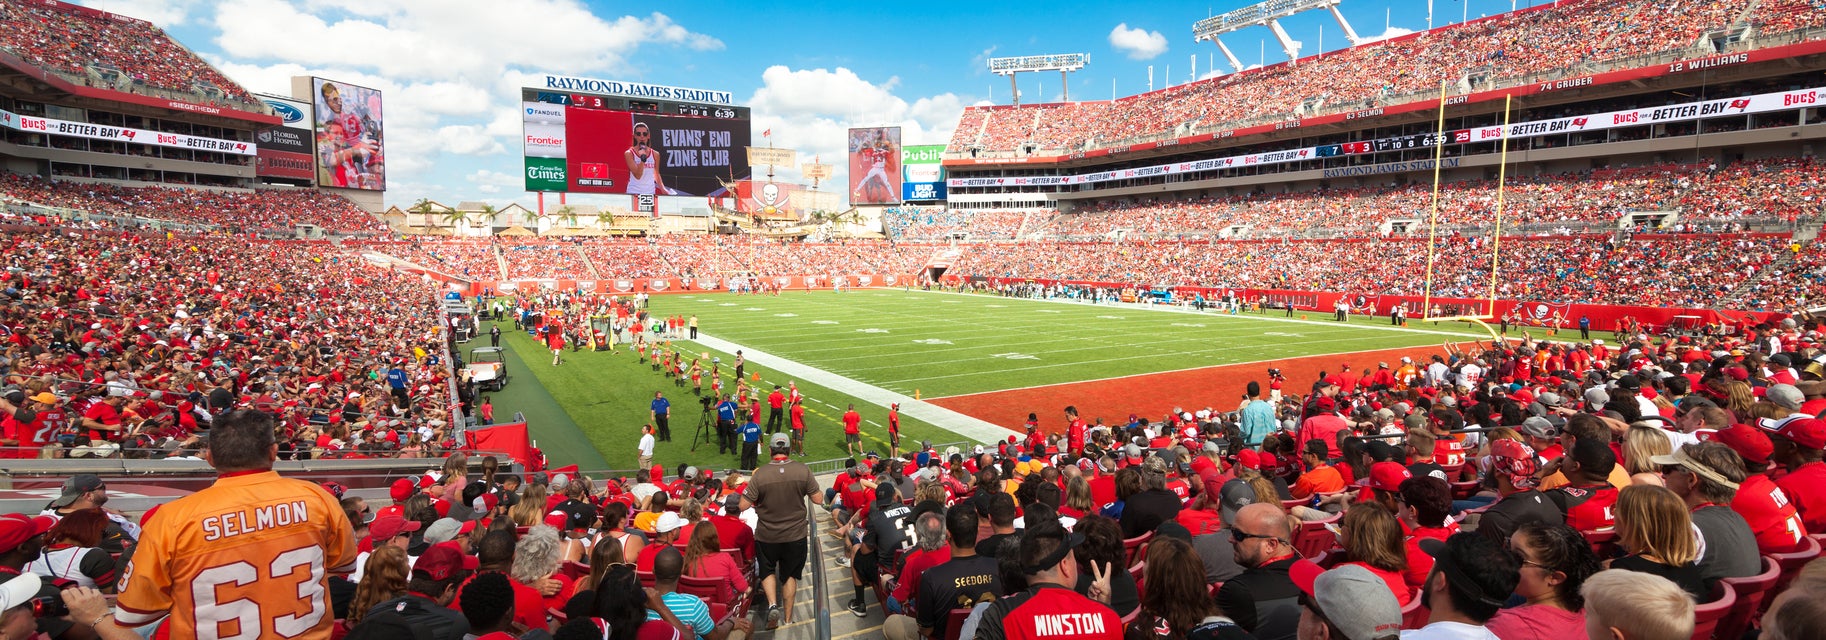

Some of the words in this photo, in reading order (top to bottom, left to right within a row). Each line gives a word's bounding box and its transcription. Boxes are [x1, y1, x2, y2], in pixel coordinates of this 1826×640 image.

[1669, 63, 1683, 73] 12
[1689, 53, 1749, 70] WILLIAMS
[546, 76, 623, 96] RAYMOND
[625, 84, 670, 99] JAMES
[674, 90, 730, 104] STADIUM
[1540, 82, 1552, 91] 74
[1556, 77, 1593, 89] GRUBER
[560, 96, 567, 104] 7
[594, 99, 601, 107] 3
[1784, 91, 1817, 106] BUCS
[169, 102, 220, 115] #SIEGETHEDAY
[534, 109, 562, 119] FANDUEL
[715, 110, 735, 119] 6:39
[1357, 108, 1384, 118] SELMON
[1613, 111, 1639, 124] BUCS
[1652, 105, 1698, 120] BETTER
[1701, 101, 1728, 115] BAY
[21, 117, 46, 131] BUCS
[59, 123, 97, 136] BETTER
[100, 126, 120, 139] BAY
[1481, 127, 1501, 139] BUCS
[1511, 122, 1547, 136] BETTER
[1550, 119, 1571, 132] BAY
[273, 130, 299, 140] FLORIDA
[527, 135, 563, 145] Frontier
[661, 129, 706, 147] EVANS'
[709, 130, 731, 148] END
[1456, 132, 1469, 141] 25
[157, 133, 177, 144] BUCS
[187, 138, 217, 149] BETTER
[219, 142, 235, 152] BAY
[273, 137, 303, 147] HOSPITAL
[1363, 143, 1370, 152] 3
[1392, 141, 1402, 149] 10
[1263, 153, 1284, 162] BETTER
[1285, 151, 1298, 160] BAY
[1332, 146, 1338, 155] 7
[666, 149, 698, 168] ZONE
[701, 149, 729, 167] CLUB
[1195, 161, 1214, 169] BETTER
[1214, 159, 1225, 167] BAY
[527, 166, 565, 180] Times
[1324, 166, 1370, 178] RAYMOND
[1372, 162, 1407, 173] JAMES
[1410, 158, 1459, 170] STADUM
[642, 195, 652, 204] 25
[911, 190, 937, 199] LIGHT
[883, 506, 911, 519] WINSTON
[202, 501, 308, 541] SELMON
[954, 574, 993, 588] SEEDORF
[192, 544, 326, 640] 63
[1034, 612, 1106, 637] WINSTON
